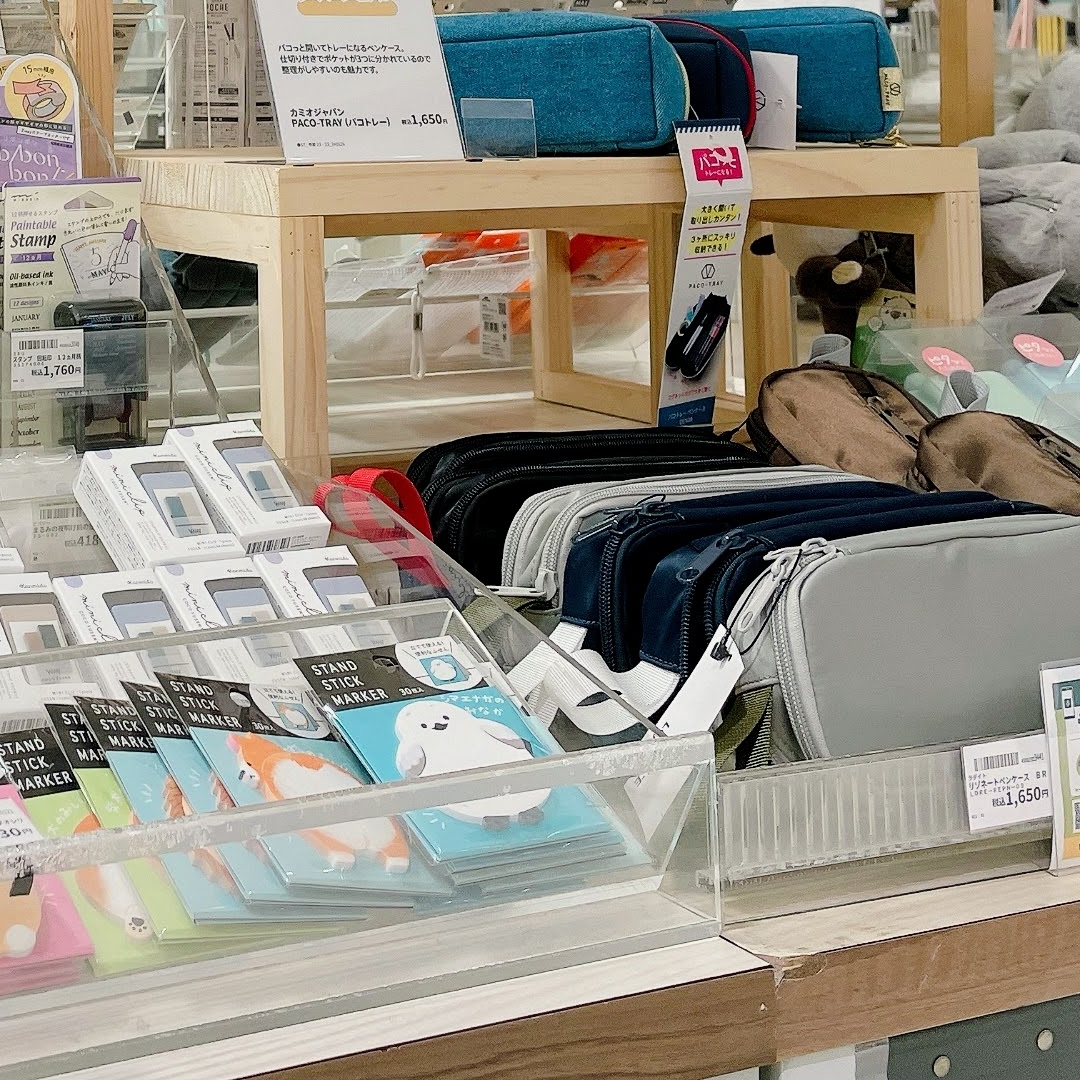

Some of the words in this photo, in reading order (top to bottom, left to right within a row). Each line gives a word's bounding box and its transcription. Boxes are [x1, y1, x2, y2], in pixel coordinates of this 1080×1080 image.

[290, 108, 345, 117] カミオジャパン
[291, 118, 343, 128] PACO-TRAY
[402, 114, 448, 127] 税込1,650円
[11, 220, 57, 231] Paintable
[10, 233, 56, 248] Stamp
[10, 271, 41, 281] Oil-based
[42, 270, 54, 278] ink
[12, 313, 41, 322] JANUARY
[32, 364, 81, 378] 税込1,760円
[311, 660, 358, 677] STAND
[170, 680, 214, 697] STAND
[322, 675, 365, 691] STICK
[179, 695, 220, 712] STICK
[331, 688, 390, 706] MARKER
[188, 711, 243, 729] MARKER
[5, 755, 50, 775] STICK
[18, 771, 73, 792] MARKER
[1036, 770, 1047, 779] BR
[992, 787, 1049, 808] 税込1,650円
